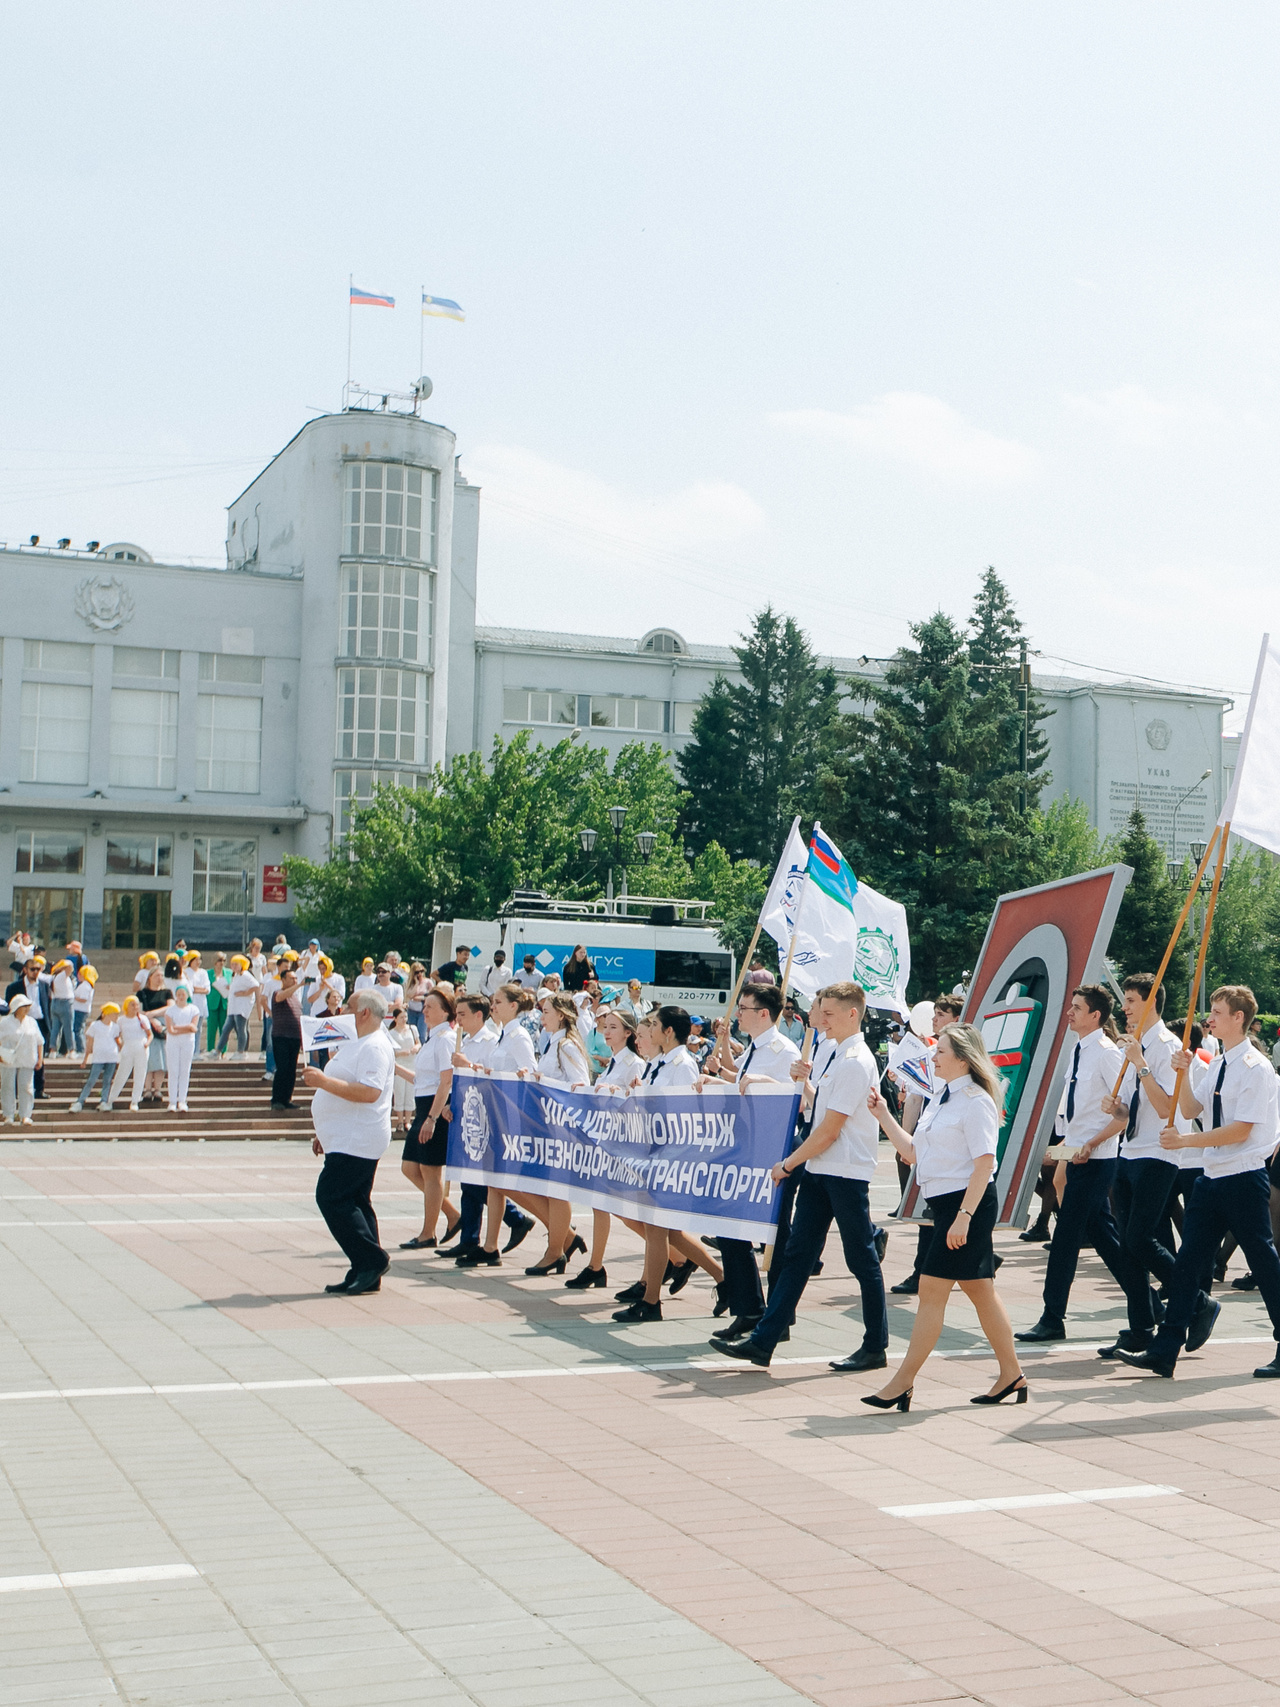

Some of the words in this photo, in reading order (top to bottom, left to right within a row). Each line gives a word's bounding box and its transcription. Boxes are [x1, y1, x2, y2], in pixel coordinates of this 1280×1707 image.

[1147, 767, 1170, 777] УКАЗ
[678, 992, 716, 1000] 220-777
[645, 1112, 736, 1152] КОЛЛЕДЖ
[647, 1159, 773, 1205] ТРАНСПОРТА
